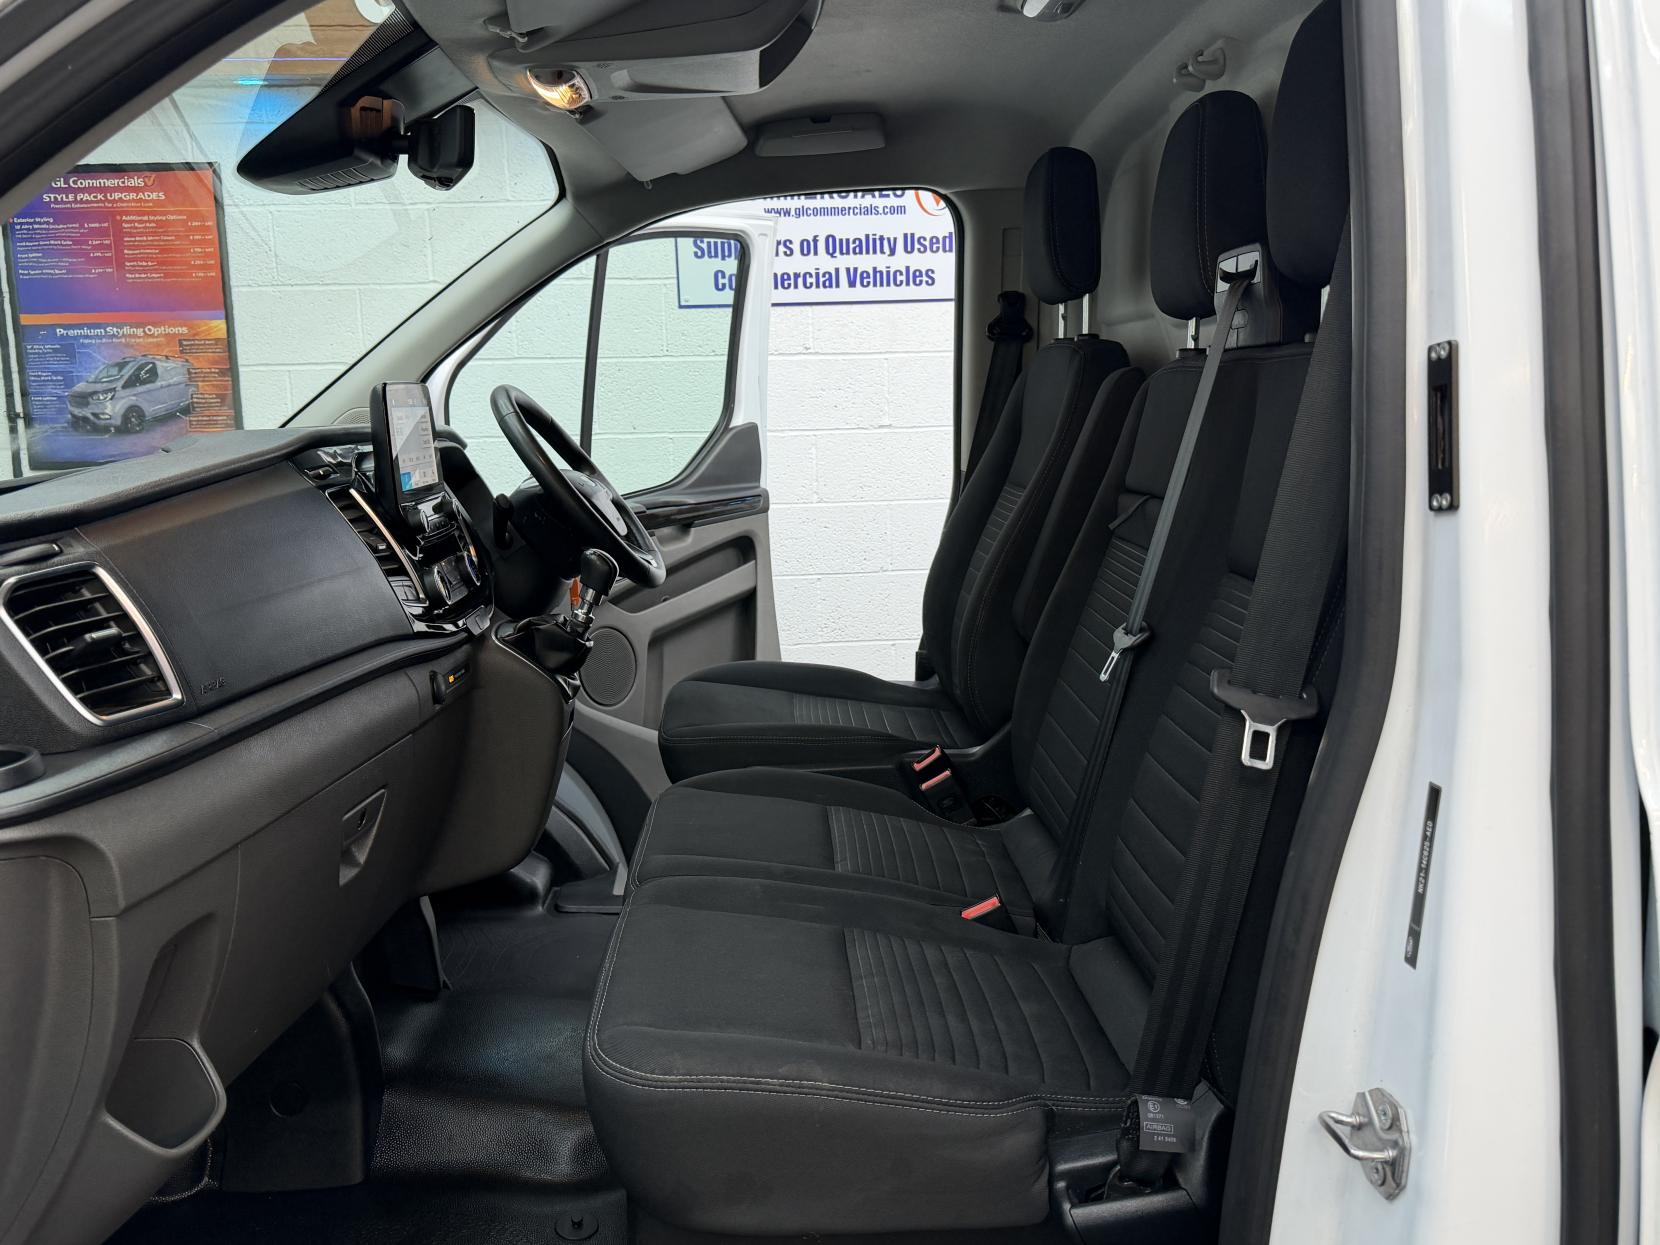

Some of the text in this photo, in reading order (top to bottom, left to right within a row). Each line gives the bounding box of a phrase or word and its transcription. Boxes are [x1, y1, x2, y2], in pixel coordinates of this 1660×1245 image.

[51, 176, 145, 188] GL Commercials
[42, 191, 166, 202] STYLE PACK UPGRADES
[764, 203, 906, 219] www.glcommercials.com
[800, 235, 819, 256] of
[824, 232, 898, 258] Quality
[903, 231, 953, 254] Used
[845, 264, 936, 289] Vehicles
[56, 325, 189, 337] Premium Styling Options
[1146, 1124, 1172, 1132] AIRBAG
